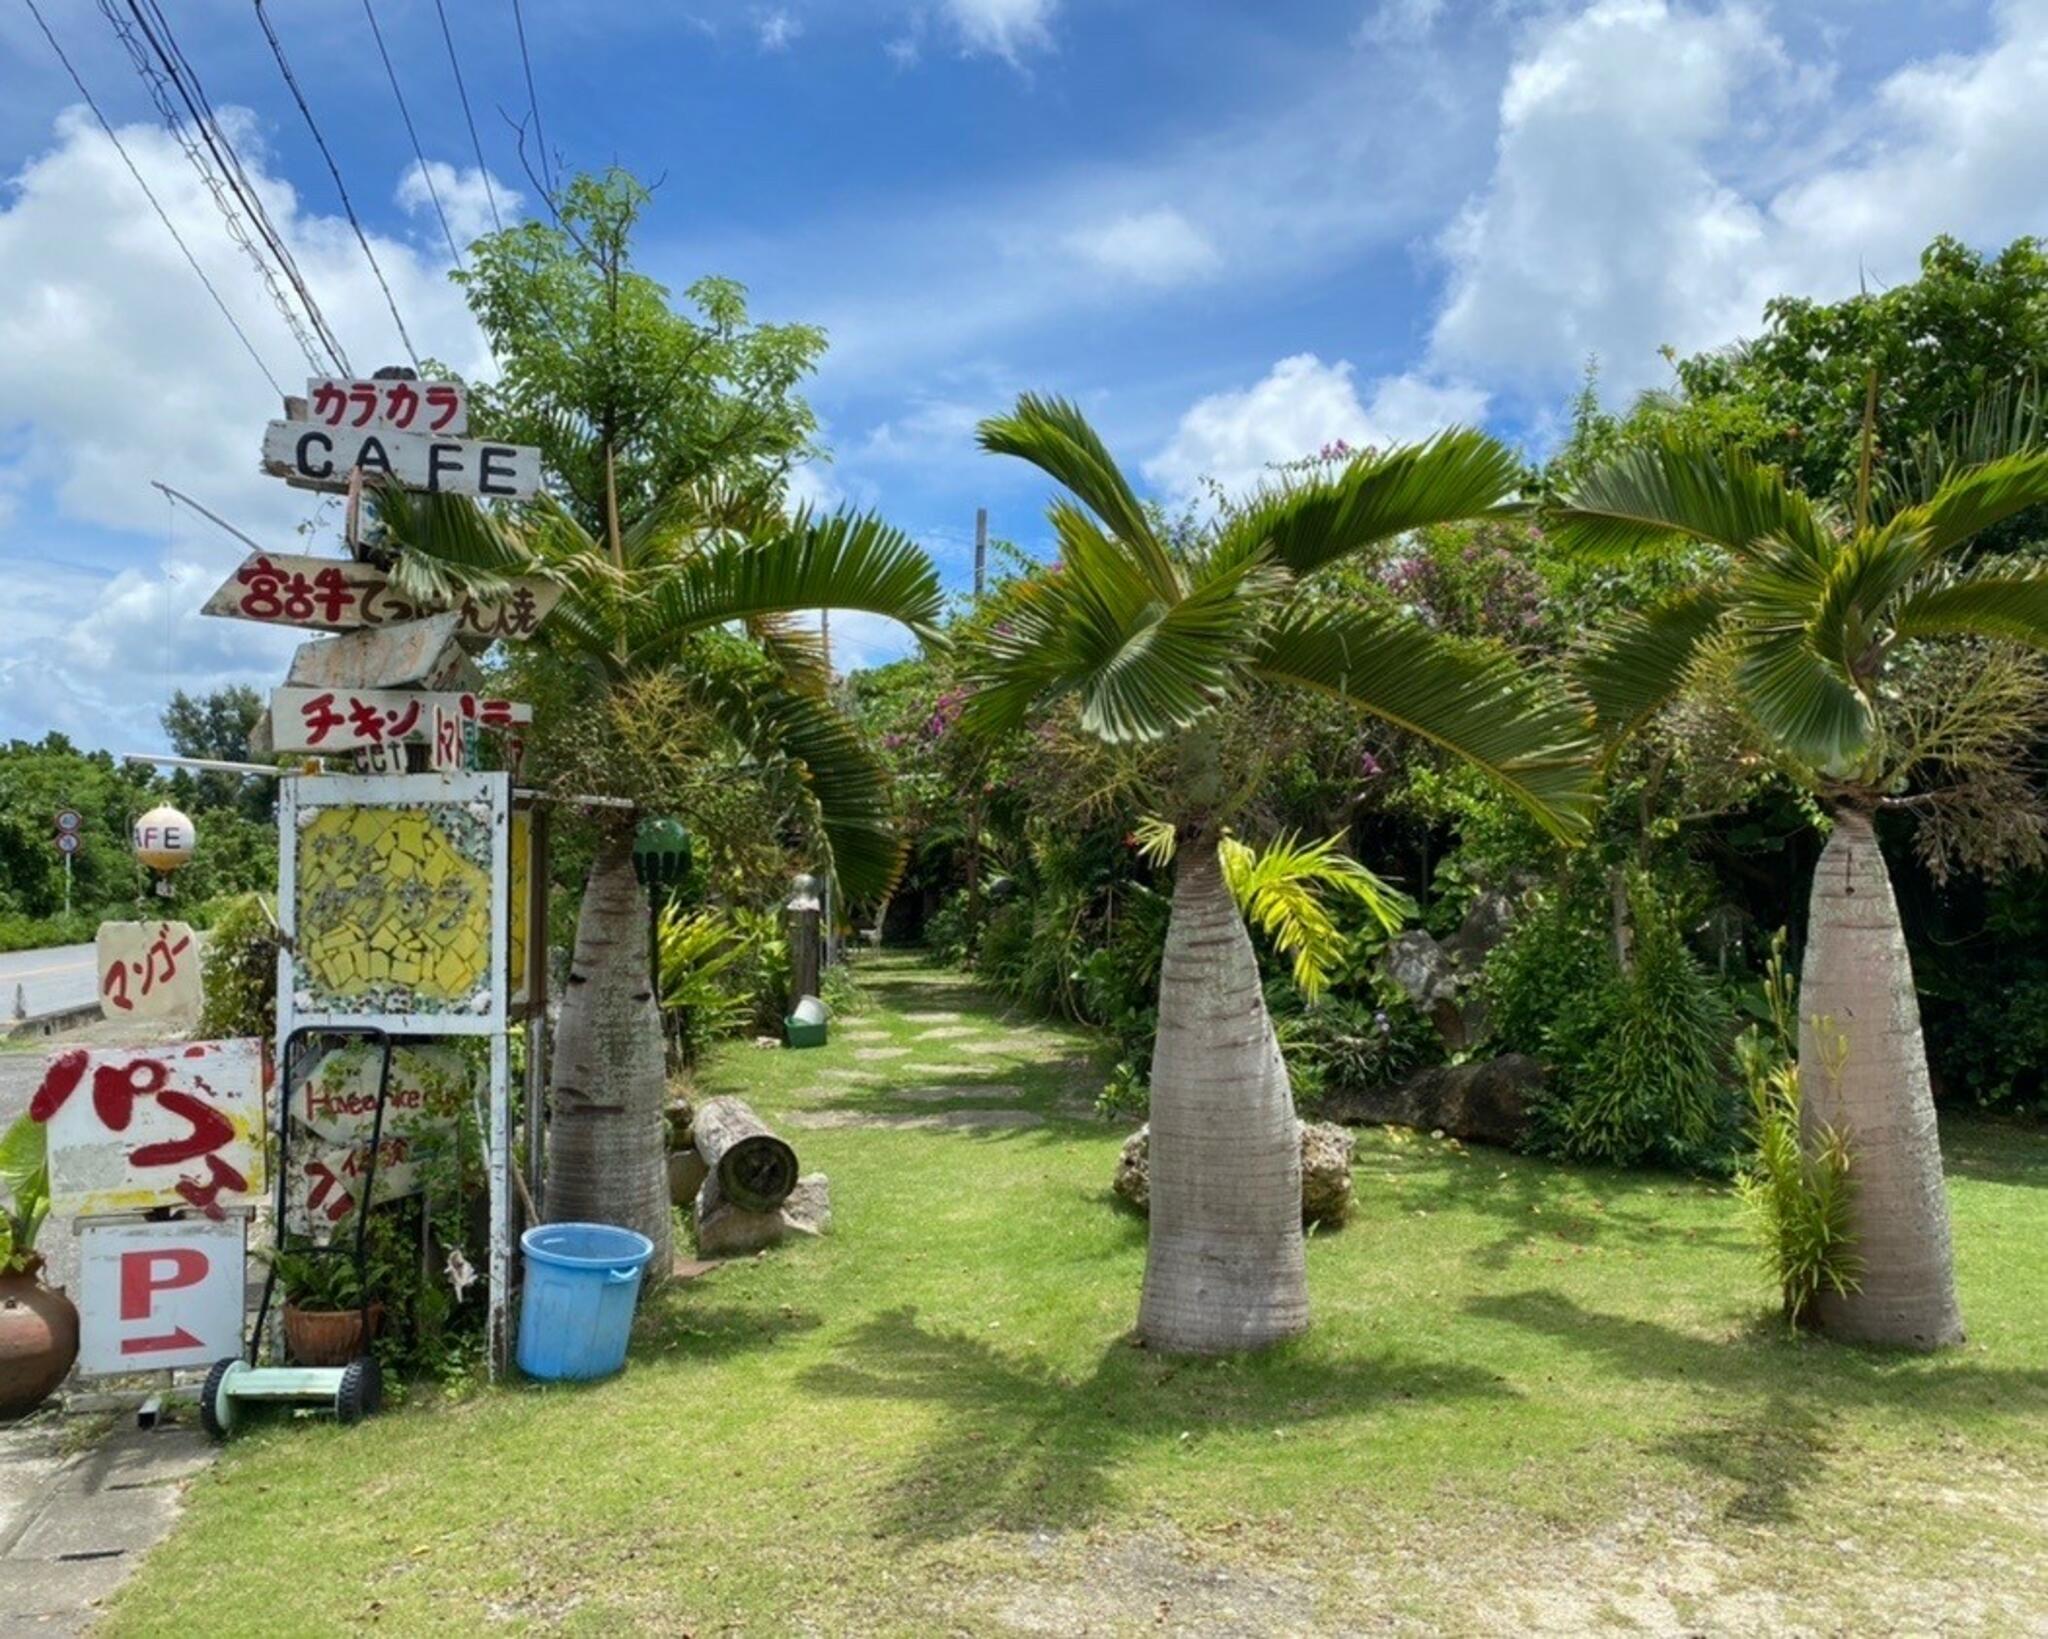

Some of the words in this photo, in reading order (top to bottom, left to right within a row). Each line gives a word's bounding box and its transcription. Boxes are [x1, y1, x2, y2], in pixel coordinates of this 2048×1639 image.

[312, 381, 459, 431] カラカラ
[296, 431, 517, 495] CAFE
[104, 923, 190, 1010] マンゴー
[29, 1050, 249, 1221] パフェ
[120, 1248, 210, 1321] P
